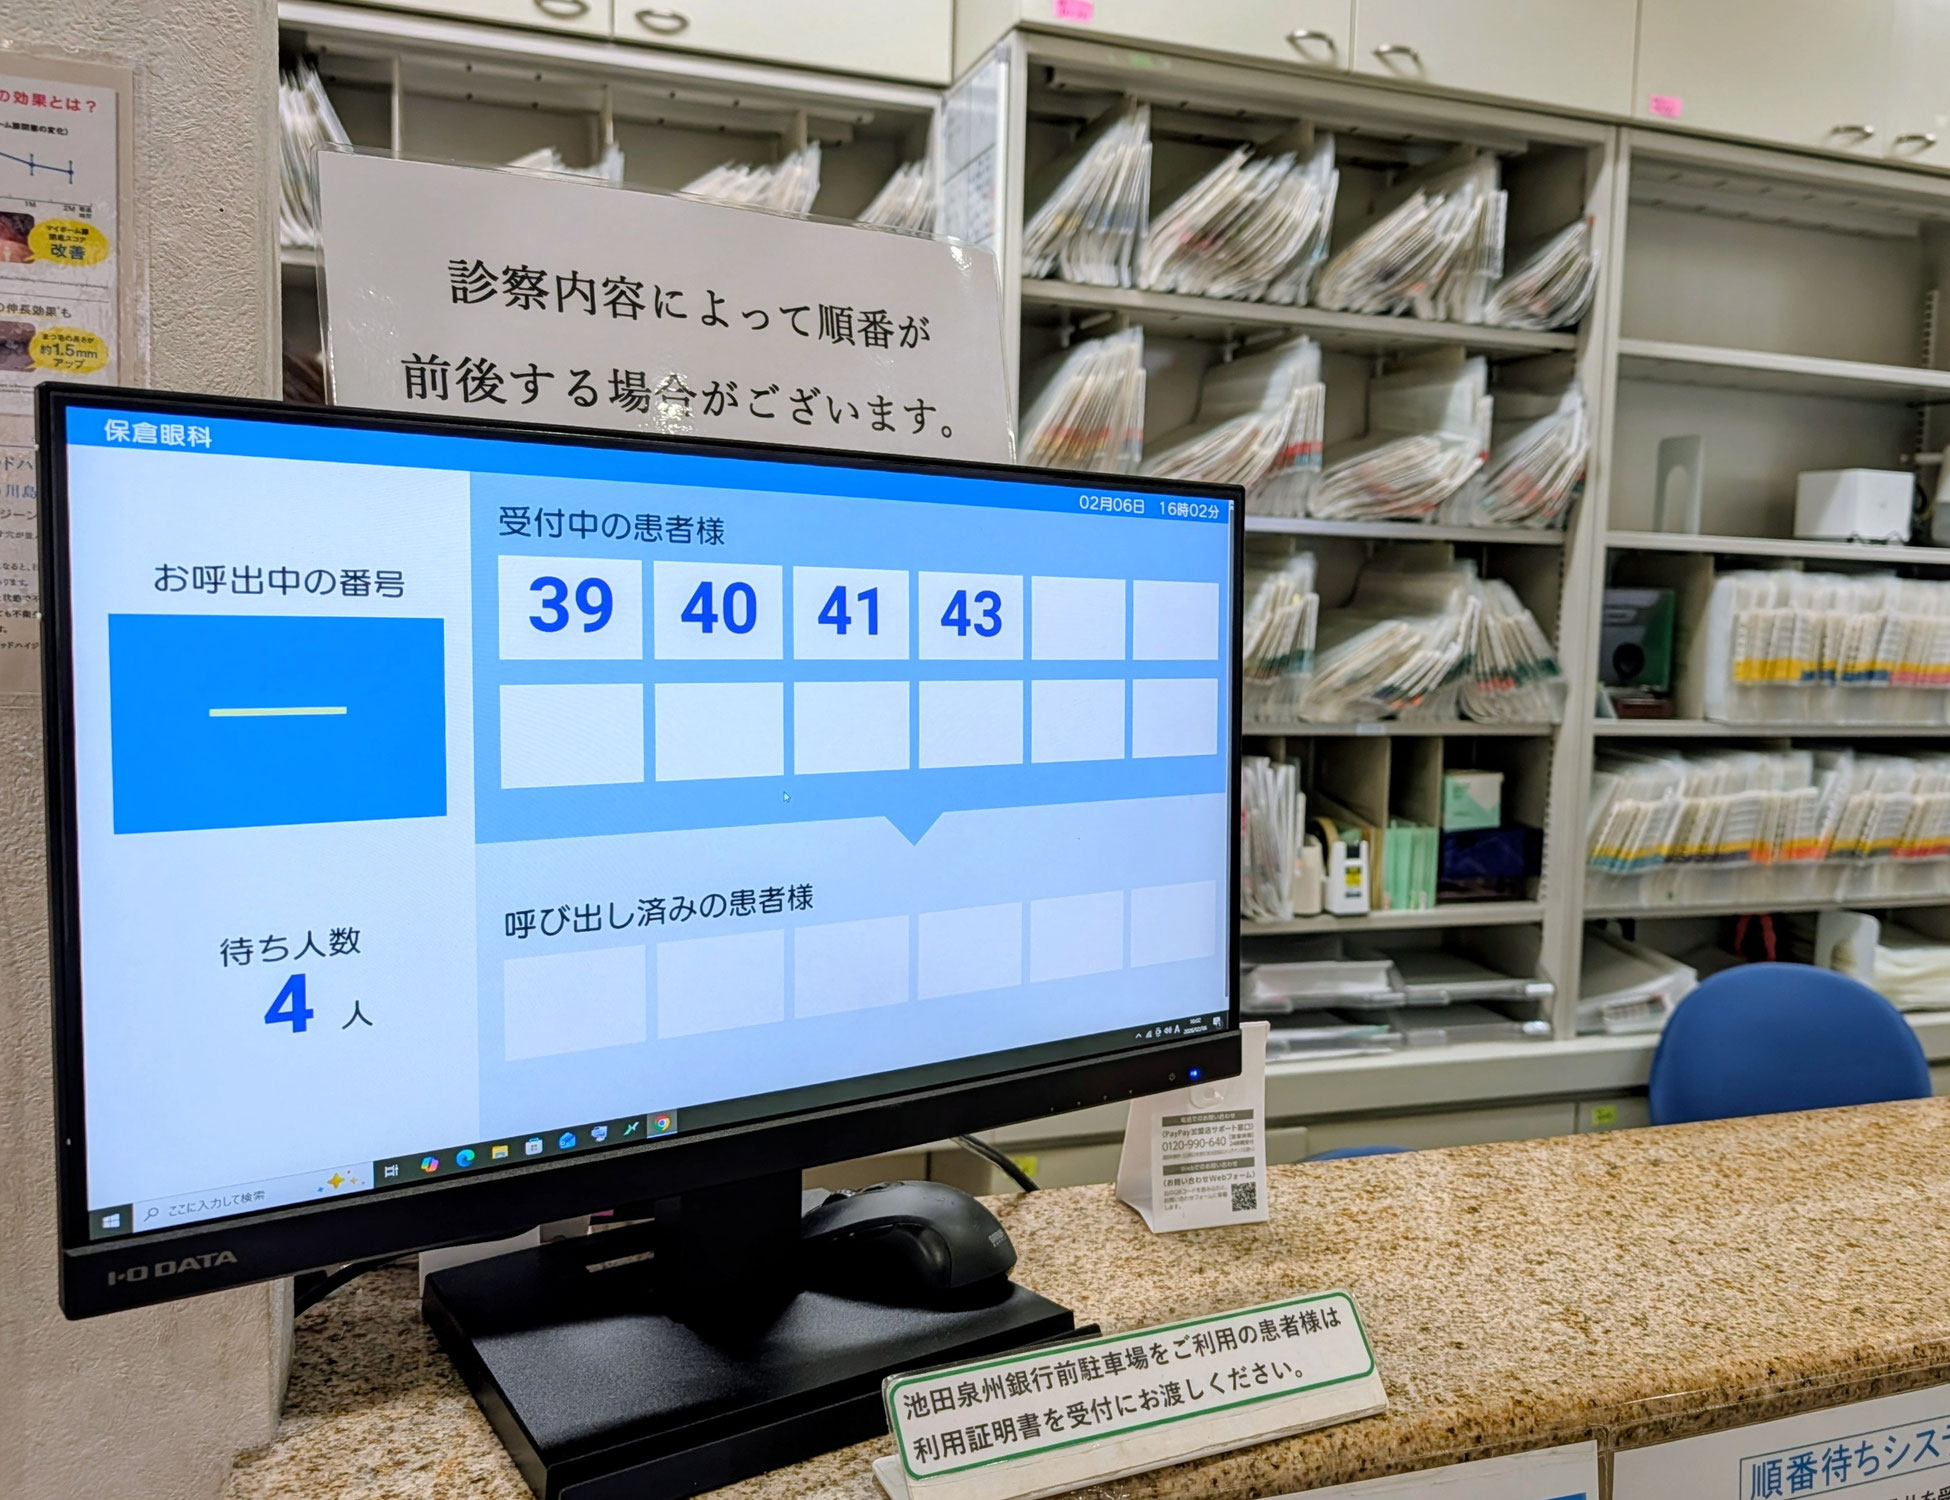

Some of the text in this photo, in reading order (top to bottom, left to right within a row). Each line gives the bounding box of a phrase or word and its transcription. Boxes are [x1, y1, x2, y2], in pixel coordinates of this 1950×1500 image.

[51, 243, 86, 260] 改善
[448, 257, 931, 350] 診察内容によって順番が
[40, 343, 98, 359] 約1.5mm
[53, 358, 85, 369] アップ
[400, 352, 956, 440] 前後する場合がございます。
[104, 418, 213, 449] 保倉眼科
[498, 506, 726, 546] 受付中の患者様
[1078, 494, 1220, 521] 02月06日 16時02分
[153, 563, 406, 599] お呼出中の番号
[529, 576, 1002, 638] 39 40 41 43
[504, 882, 815, 940] 呼び出し済みの患者様
[219, 926, 362, 968] 待ち人数
[264, 973, 373, 1033] 4 人
[1162, 1136, 1227, 1152] 0120-990-640
[168, 1190, 265, 1217] ここに入力して検索
[154, 1249, 239, 1278] DATA
[903, 1306, 1343, 1420] 池田泉州銀行前駐車場をご利用の患者様は
[913, 1360, 1305, 1463] 利用証明書を受付にお渡しください。
